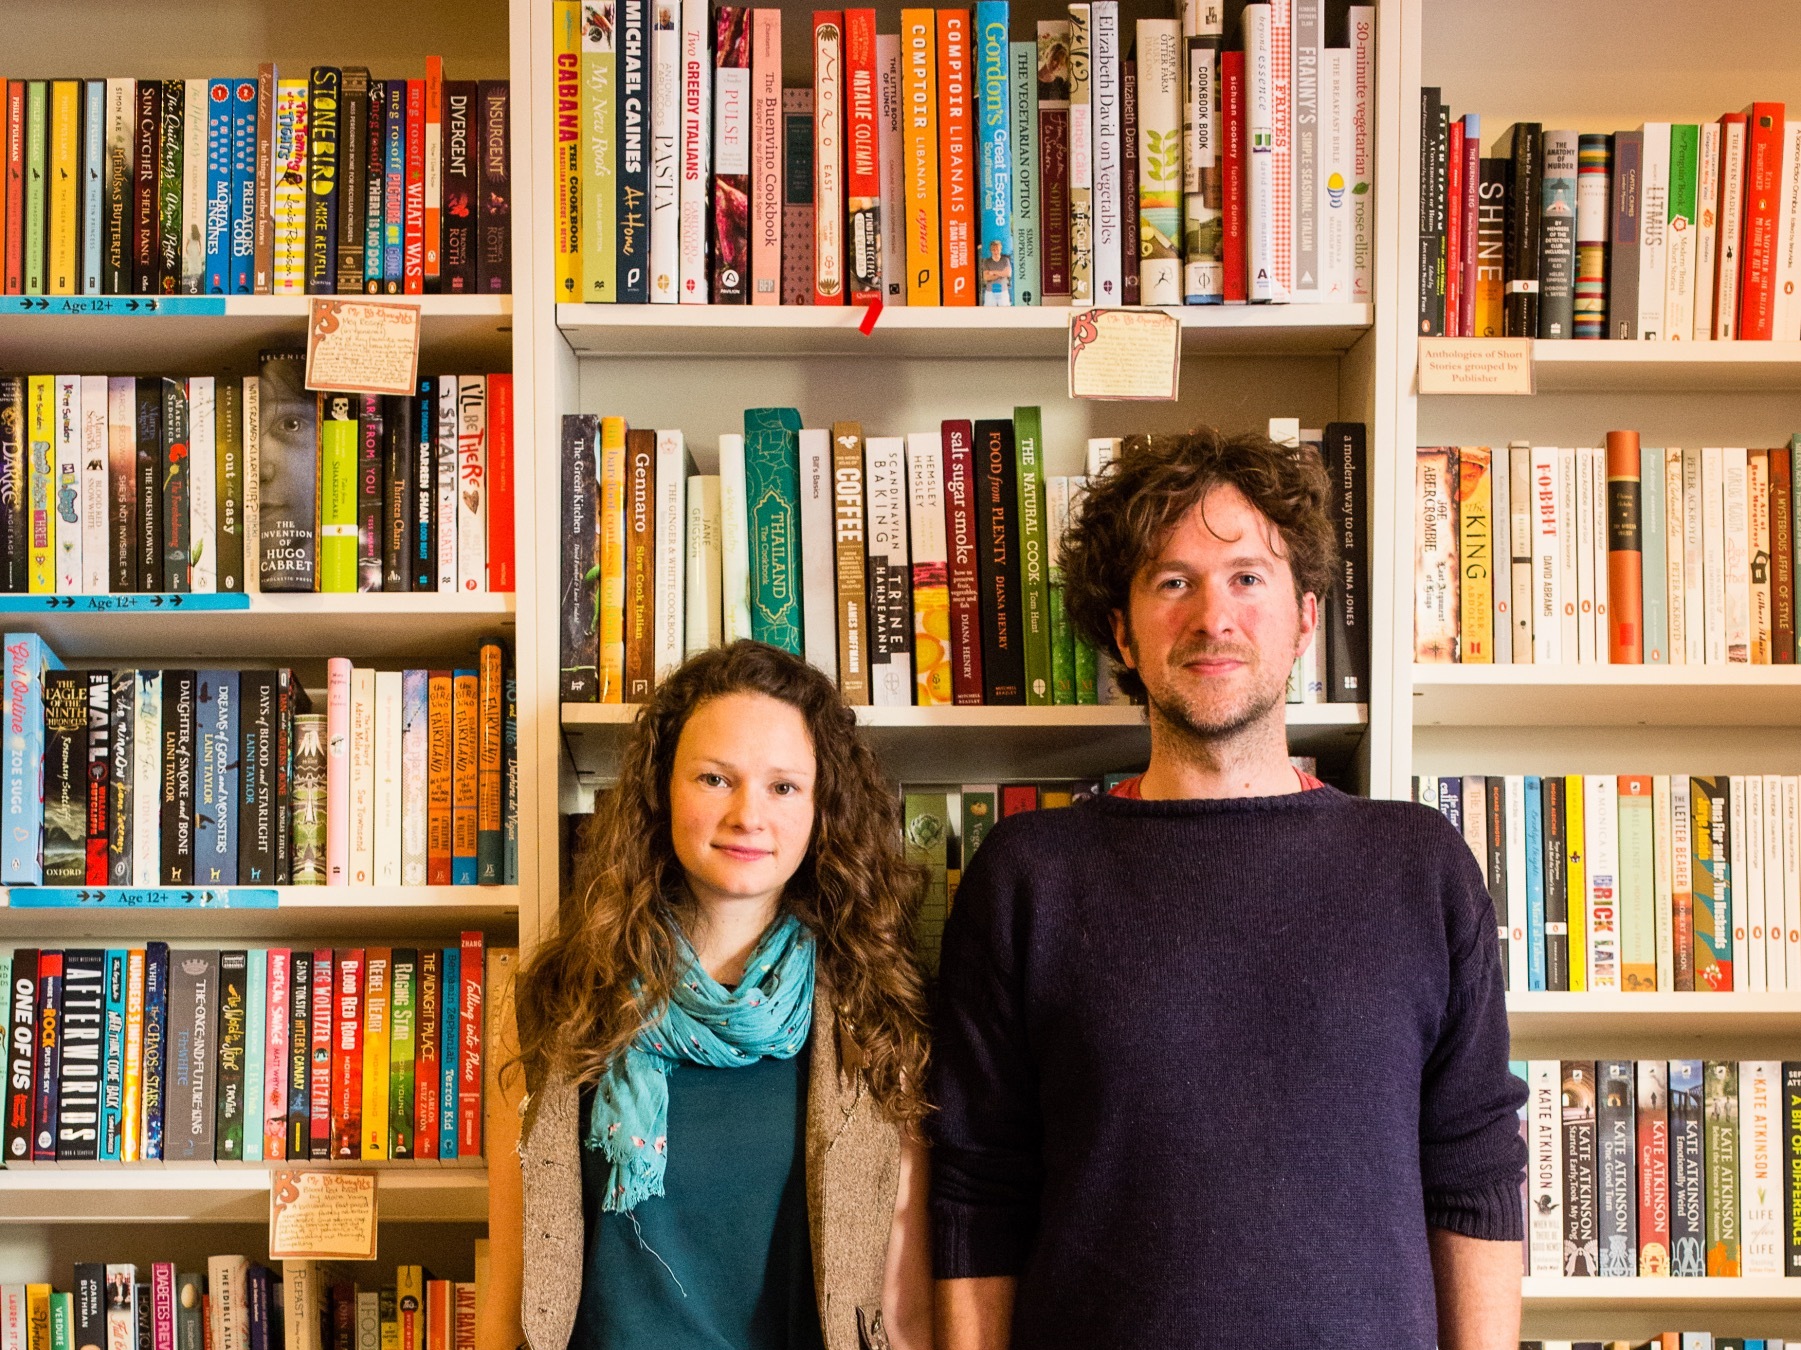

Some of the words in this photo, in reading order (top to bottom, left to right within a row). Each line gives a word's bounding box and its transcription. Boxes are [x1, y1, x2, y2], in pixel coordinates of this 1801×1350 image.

[625, 1, 641, 96] MICHAEL
[1098, 16, 1114, 89] Elizabeth
[948, 20, 964, 119] COMPTOIR
[986, 23, 1006, 126] Gordon's
[141, 88, 154, 116] SUN
[558, 54, 578, 142] CABANA
[725, 91, 738, 146] PULSE
[1100, 94, 1114, 137] David
[140, 118, 154, 181] CATCHER
[310, 70, 337, 196] STONEBIRD
[450, 96, 467, 177] DIVERGENT
[487, 96, 506, 177] INSURGENT
[625, 98, 641, 174] CAINES
[1100, 142, 1110, 160] on
[950, 126, 964, 213] LIBANAIS
[216, 181, 228, 232] MORTAL
[315, 201, 328, 230] MIKE
[623, 186, 644, 209] At
[1097, 165, 1114, 245] Vegetables
[208, 200, 218, 255] ENGINES
[620, 213, 644, 256] Home
[1477, 182, 1504, 281] SHINE
[314, 236, 328, 277] REVELL
[63, 301, 86, 314] Age
[91, 300, 114, 311] 12+
[1425, 350, 1483, 359] Anthologies
[1484, 350, 1495, 358] of
[1498, 350, 1522, 358] Short
[1429, 362, 1461, 370] Stories
[1464, 362, 1504, 372] grouped
[1508, 362, 1518, 372] by
[1452, 374, 1498, 382] Publisher
[950, 432, 968, 460] salt
[989, 432, 1001, 474] FOOD
[836, 468, 862, 543] COFFEE
[947, 463, 966, 507] sugar
[987, 476, 1002, 503] from
[145, 486, 153, 564] FORESHADOWING
[1424, 466, 1436, 552] ABERCROMBIE
[1436, 501, 1447, 520] JOE
[266, 549, 306, 559] HUGO
[771, 512, 786, 599] THAILAND
[955, 510, 973, 564] smoke
[992, 507, 1006, 566] PLENTY
[1466, 516, 1486, 579] KING
[261, 561, 313, 571] CABRET
[1544, 556, 1552, 579] DAVID
[88, 597, 112, 609] Age
[117, 596, 138, 607] 12+
[876, 567, 888, 654] HAHNEMANN
[888, 575, 903, 644] TRINE
[995, 576, 1006, 609] DIANA
[1544, 582, 1552, 617] ABRAMS
[997, 612, 1007, 650] HENRY
[7, 642, 28, 676] Girl
[11, 680, 29, 734] Online
[178, 680, 190, 745] DAUGHTER
[11, 749, 22, 776] ZOE
[179, 746, 188, 756] of
[11, 779, 22, 813] SUGG
[179, 758, 189, 797] SMOKE
[179, 800, 188, 819] and
[1675, 805, 1686, 843] LETTER
[178, 822, 188, 855] BONE
[1676, 847, 1687, 886] BEARER
[118, 892, 143, 905] Age
[148, 892, 169, 902] 12+
[1594, 875, 1614, 932] BRICK
[1679, 900, 1687, 932] ROBERT
[1594, 940, 1615, 987] LANE
[1679, 935, 1688, 970] ALLISON
[341, 961, 358, 993] BLOOD
[16, 979, 33, 1024] ONE
[341, 997, 357, 1017] RED
[15, 1026, 32, 1056] OF
[60, 968, 101, 1141] AFTERWORLDS
[341, 1021, 357, 1050] ROAD
[13, 1059, 30, 1089] US
[1614, 1120, 1626, 1155] KATE
[1686, 1120, 1697, 1155] KATE
[1675, 1136, 1685, 1188] Emotionally
[1615, 1159, 1627, 1232] ATKINSON
[1677, 1189, 1686, 1216] Weird
[1687, 1159, 1699, 1232] ATKINSON
[80, 1279, 89, 1328] BLYTHMAN
[56, 1306, 64, 1346] VERDURE
